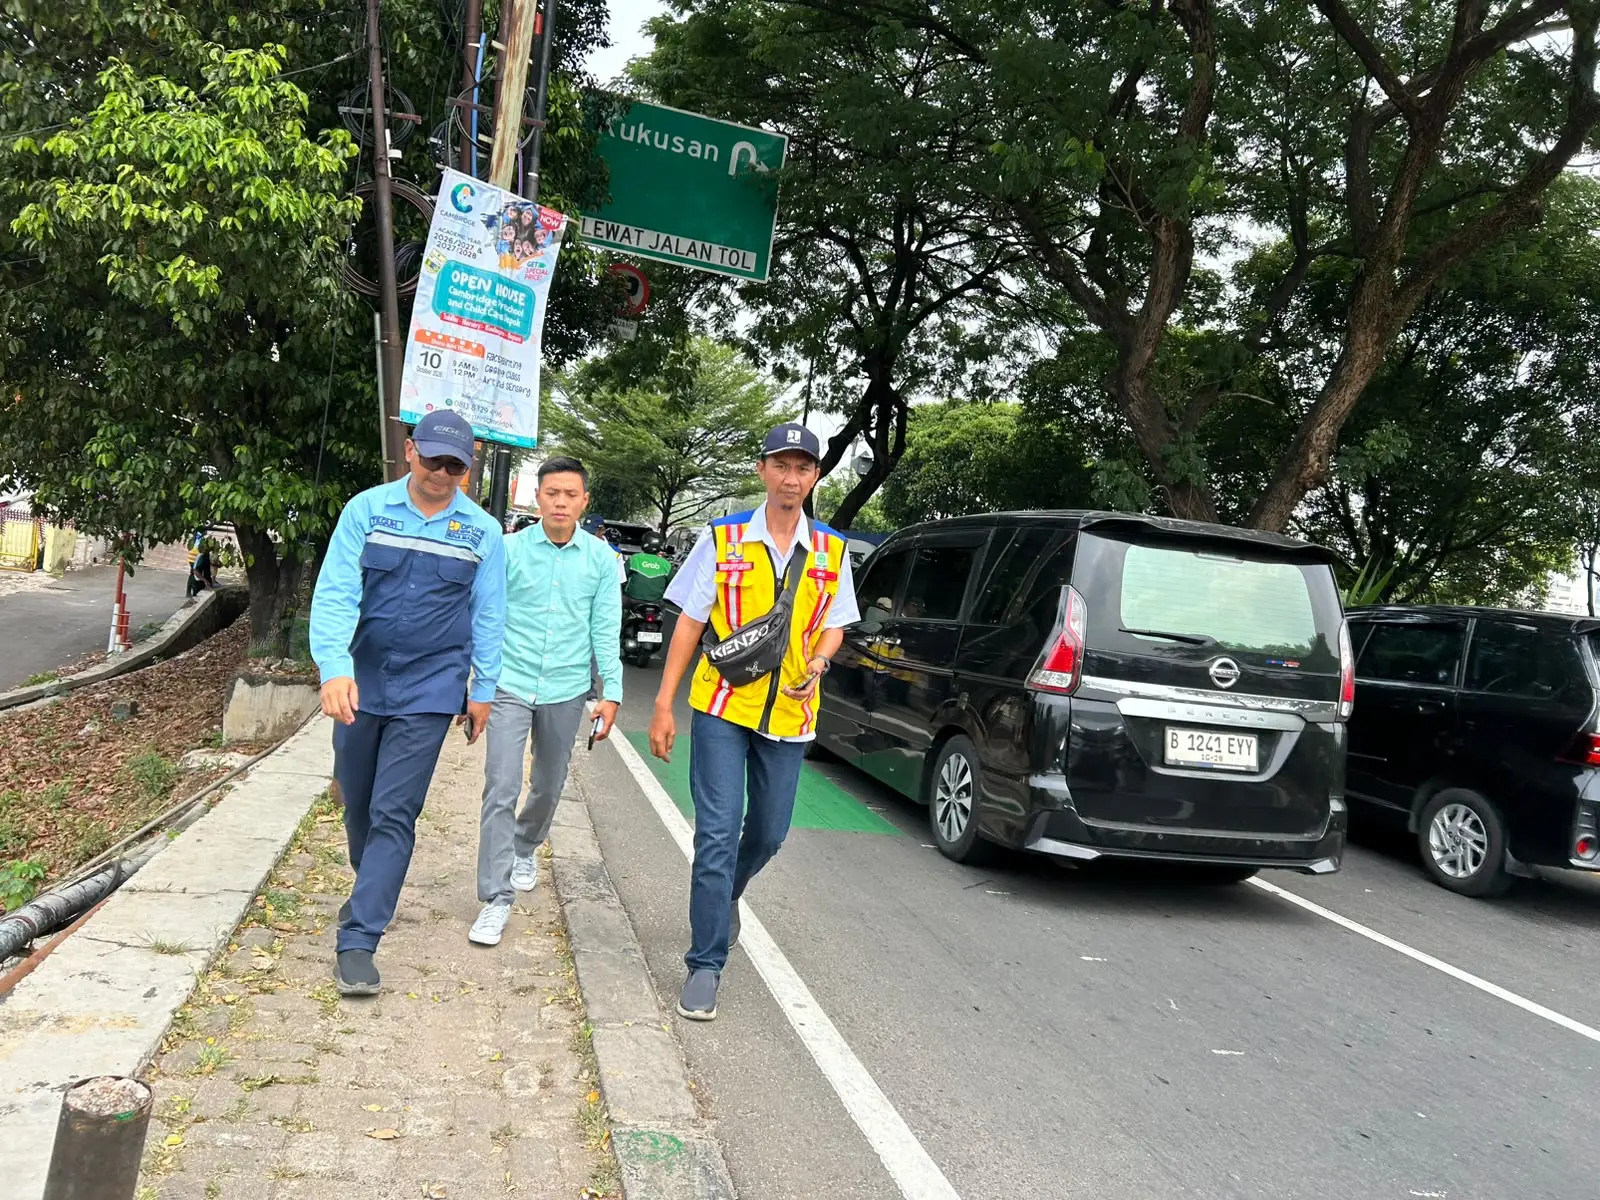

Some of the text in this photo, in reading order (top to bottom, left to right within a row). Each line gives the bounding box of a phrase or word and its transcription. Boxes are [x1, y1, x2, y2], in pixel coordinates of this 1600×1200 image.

[440, 209, 476, 226] CAMBRIDGE
[540, 215, 559, 227] NOW
[434, 233, 474, 251] 2026/2027
[438, 227, 466, 240] ACADEMIC
[437, 241, 477, 259] 2027/2028
[581, 218, 751, 270] LEWAT JALAN TOL
[448, 285, 498, 307] Cambridge
[451, 270, 526, 306] OPEN HOUSE
[464, 301, 487, 315] Child
[420, 351, 442, 369] 10
[458, 361, 471, 370] AM
[641, 561, 660, 570] Grab
[710, 624, 769, 660] KENZO
[1171, 732, 1254, 756] B 1241 EYY
